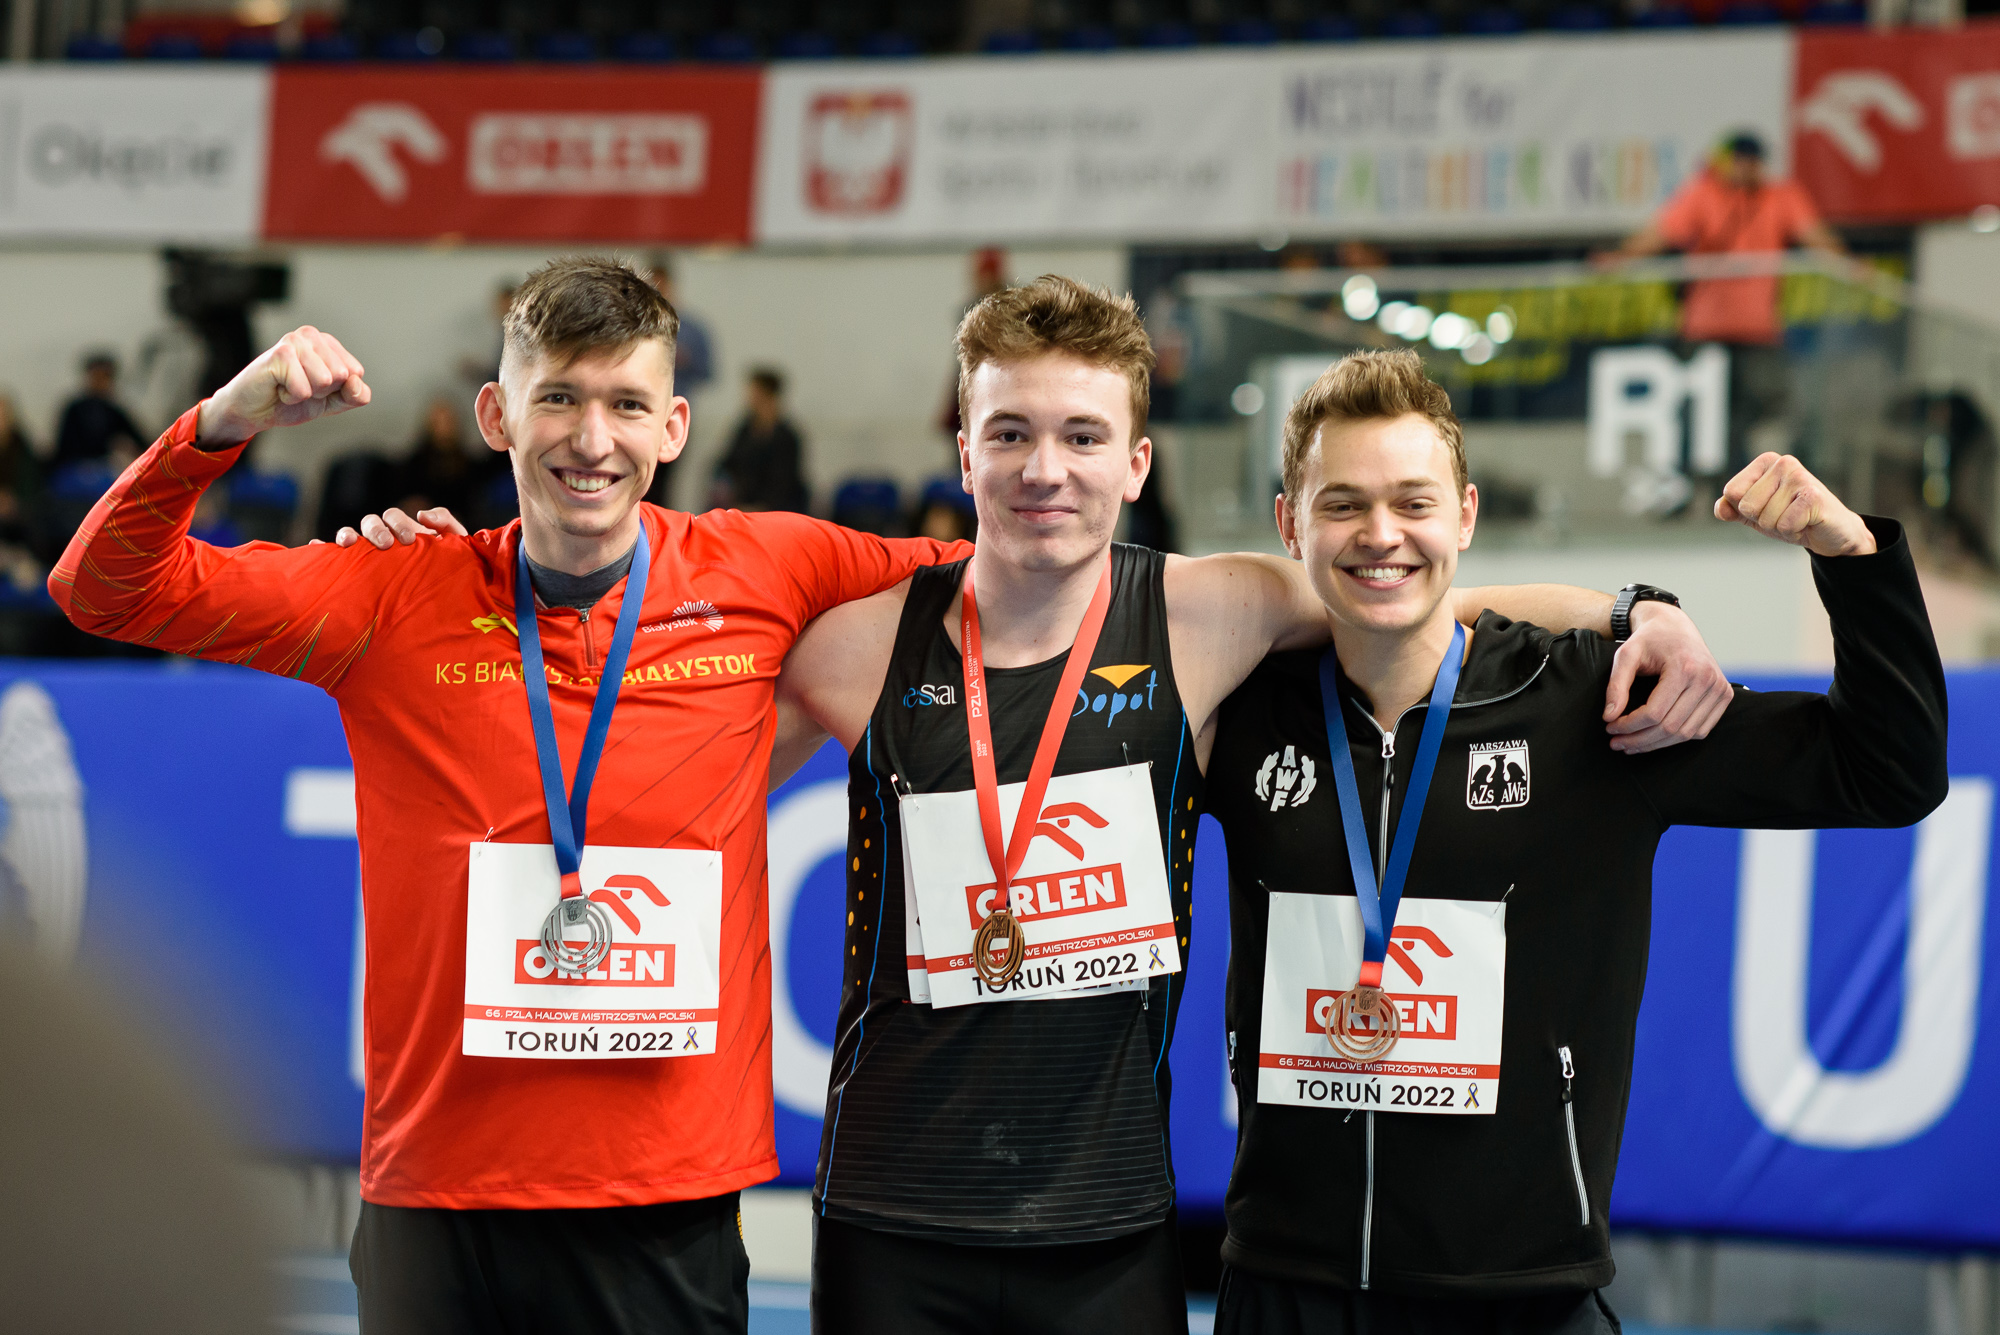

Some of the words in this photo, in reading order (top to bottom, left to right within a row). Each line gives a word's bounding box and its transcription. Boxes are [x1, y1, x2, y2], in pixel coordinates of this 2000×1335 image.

[1586, 346, 1732, 476] R1
[435, 662, 467, 685] KS
[622, 653, 757, 686] BIAŁYSTOK
[970, 678, 983, 718] PZLA
[1469, 739, 1528, 751] WARSZAWA
[1470, 784, 1494, 805] AZS
[1501, 782, 1526, 803] AWF
[949, 958, 968, 968] 66.
[1042, 935, 1117, 955] MISTRZOSTWA
[1118, 929, 1155, 943] POLSKI
[972, 958, 1065, 996] TORUŃ
[1074, 952, 1139, 982] 2022
[485, 1009, 503, 1019] 66.
[505, 1009, 534, 1020] PZLA
[534, 1011, 579, 1021] HALOWE
[580, 1011, 658, 1021] MISTRZOSTWA
[658, 1011, 696, 1021] POLSKI
[505, 1026, 599, 1052] TORUŃ
[608, 1031, 673, 1052] 2022
[1278, 1057, 1296, 1067] 66.
[1297, 1059, 1322, 1069] PZLA
[1322, 1060, 1363, 1072] HALOWE
[1364, 1063, 1439, 1076] MISTRZOSTWA
[1440, 1066, 1478, 1077] POLSKI
[1296, 1077, 1381, 1105] TORUŃ
[1390, 1085, 1456, 1108] 2022
